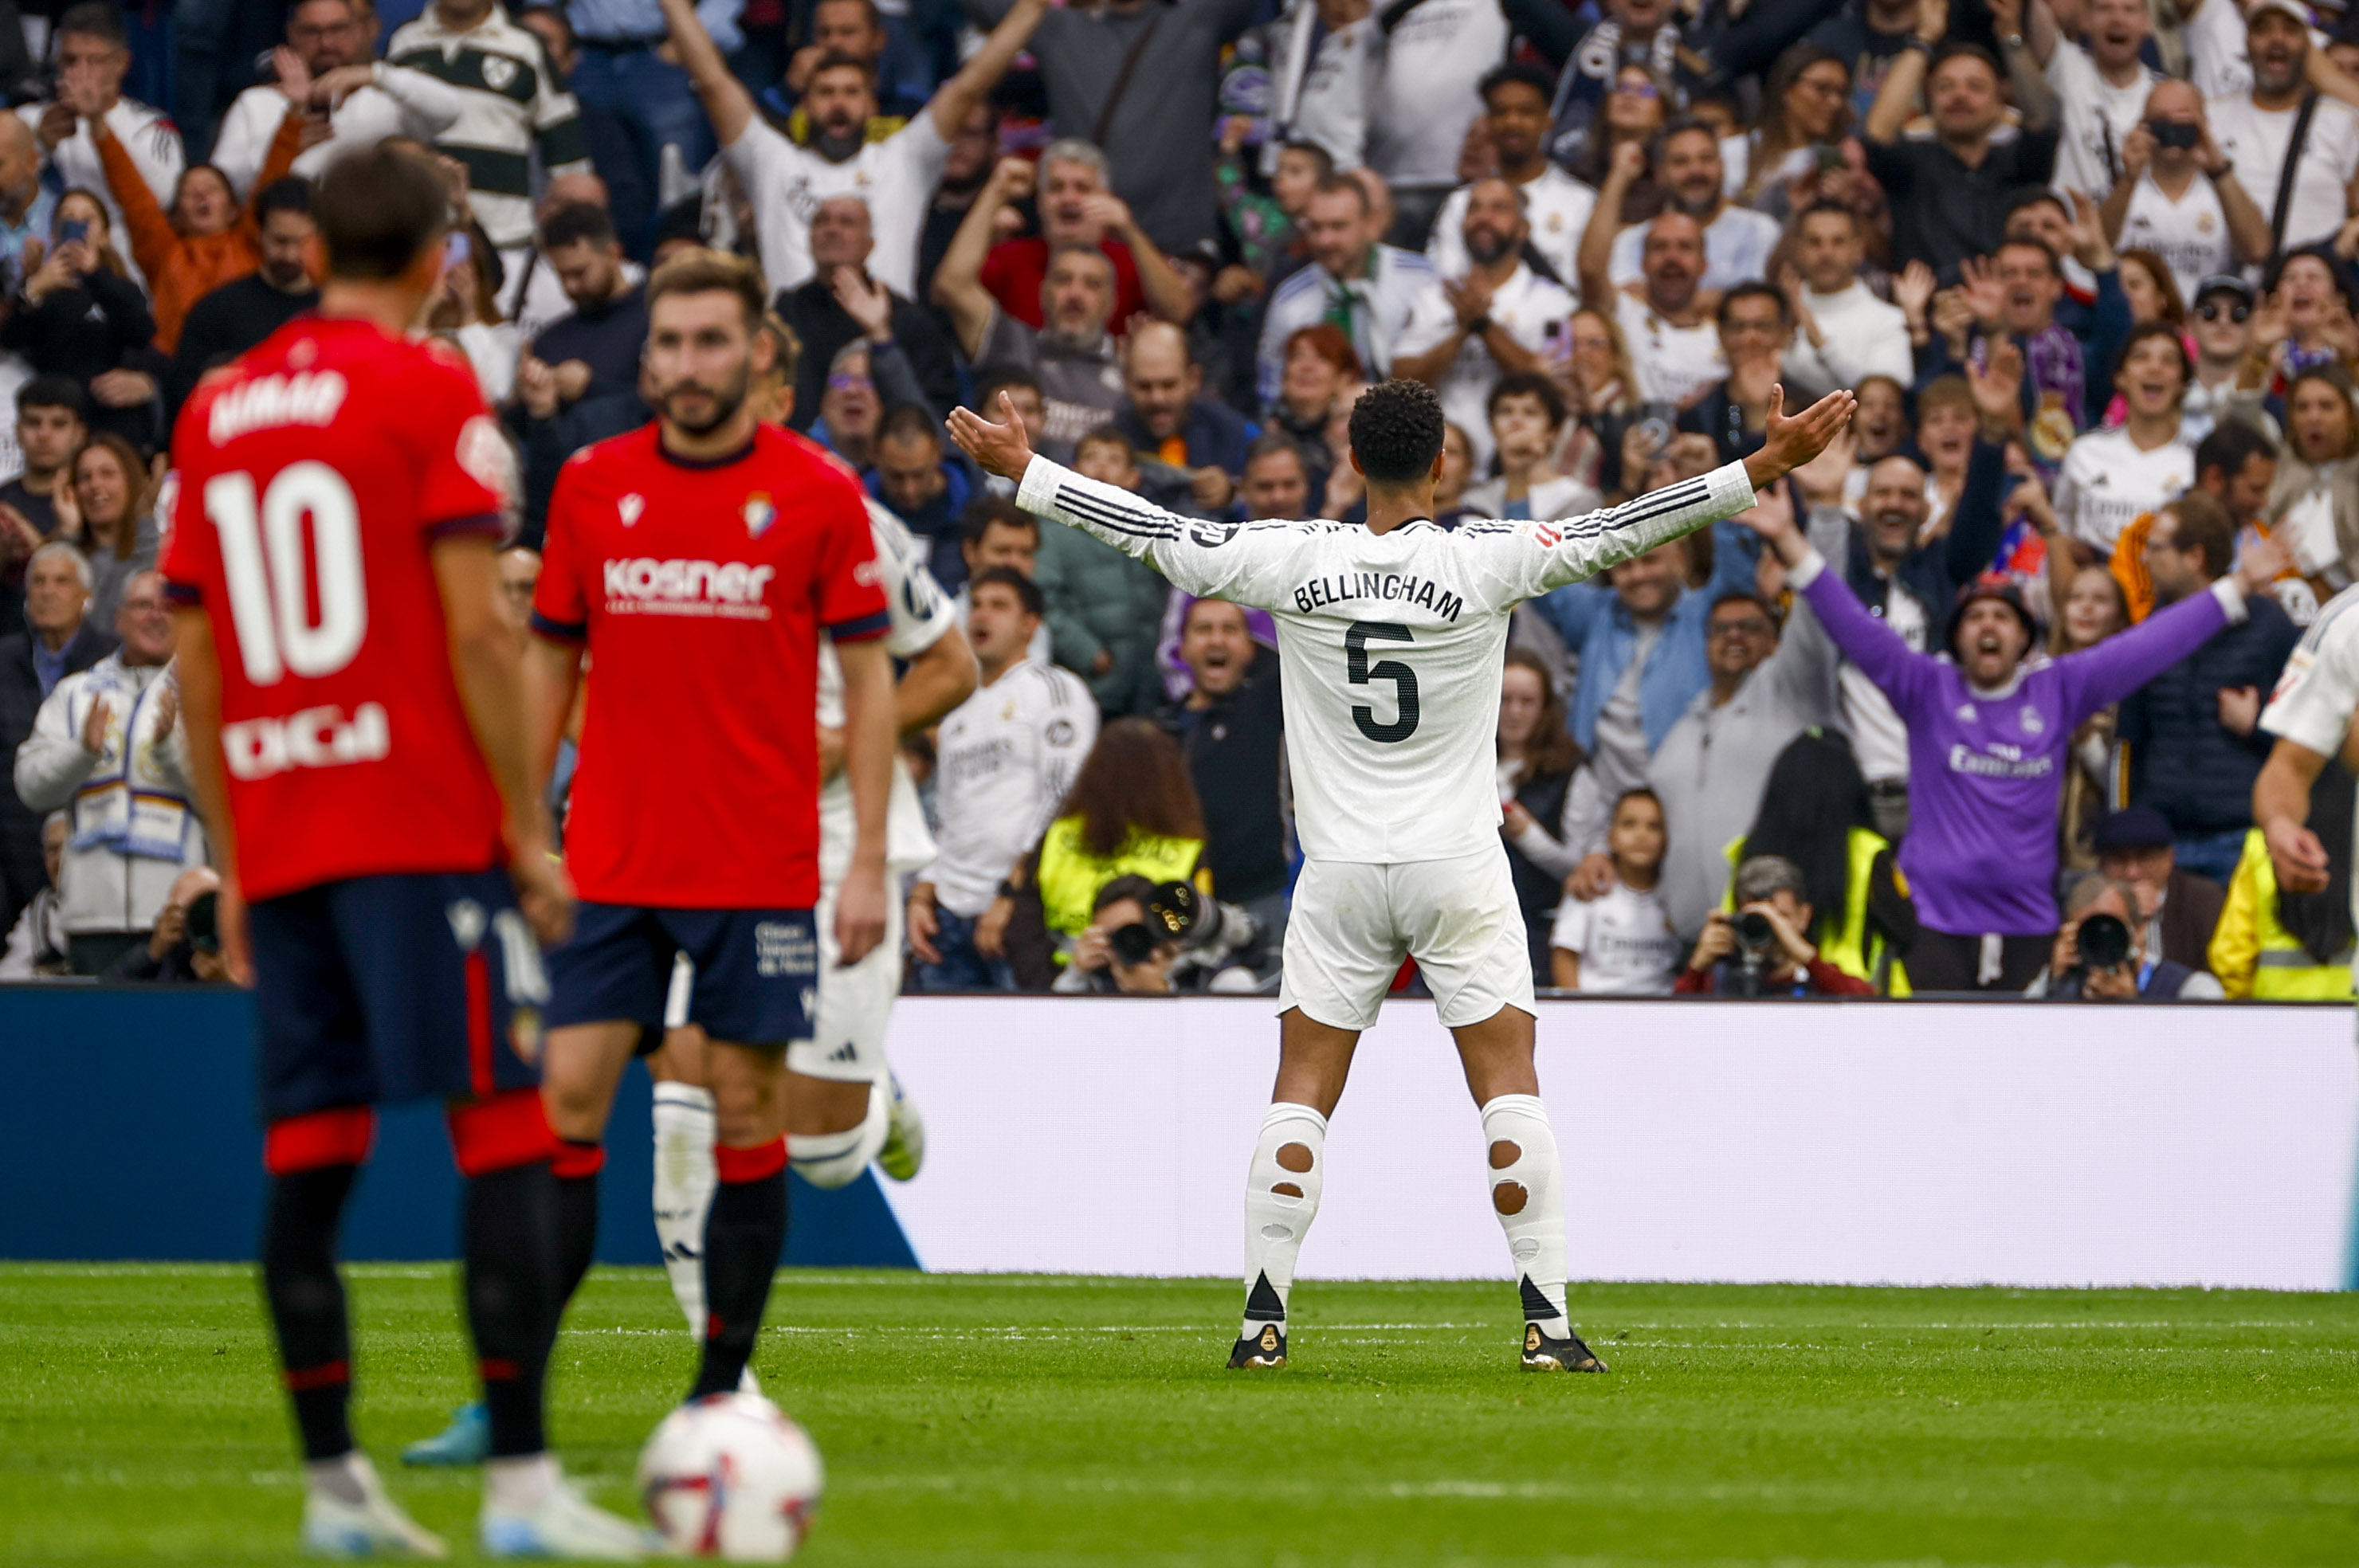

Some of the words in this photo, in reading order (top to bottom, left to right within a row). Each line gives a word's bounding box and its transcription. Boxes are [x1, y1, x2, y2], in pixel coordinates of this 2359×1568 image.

[203, 459, 367, 684] 10
[1293, 573, 1463, 623] BELLINGHAM
[1344, 621, 1420, 743] 5
